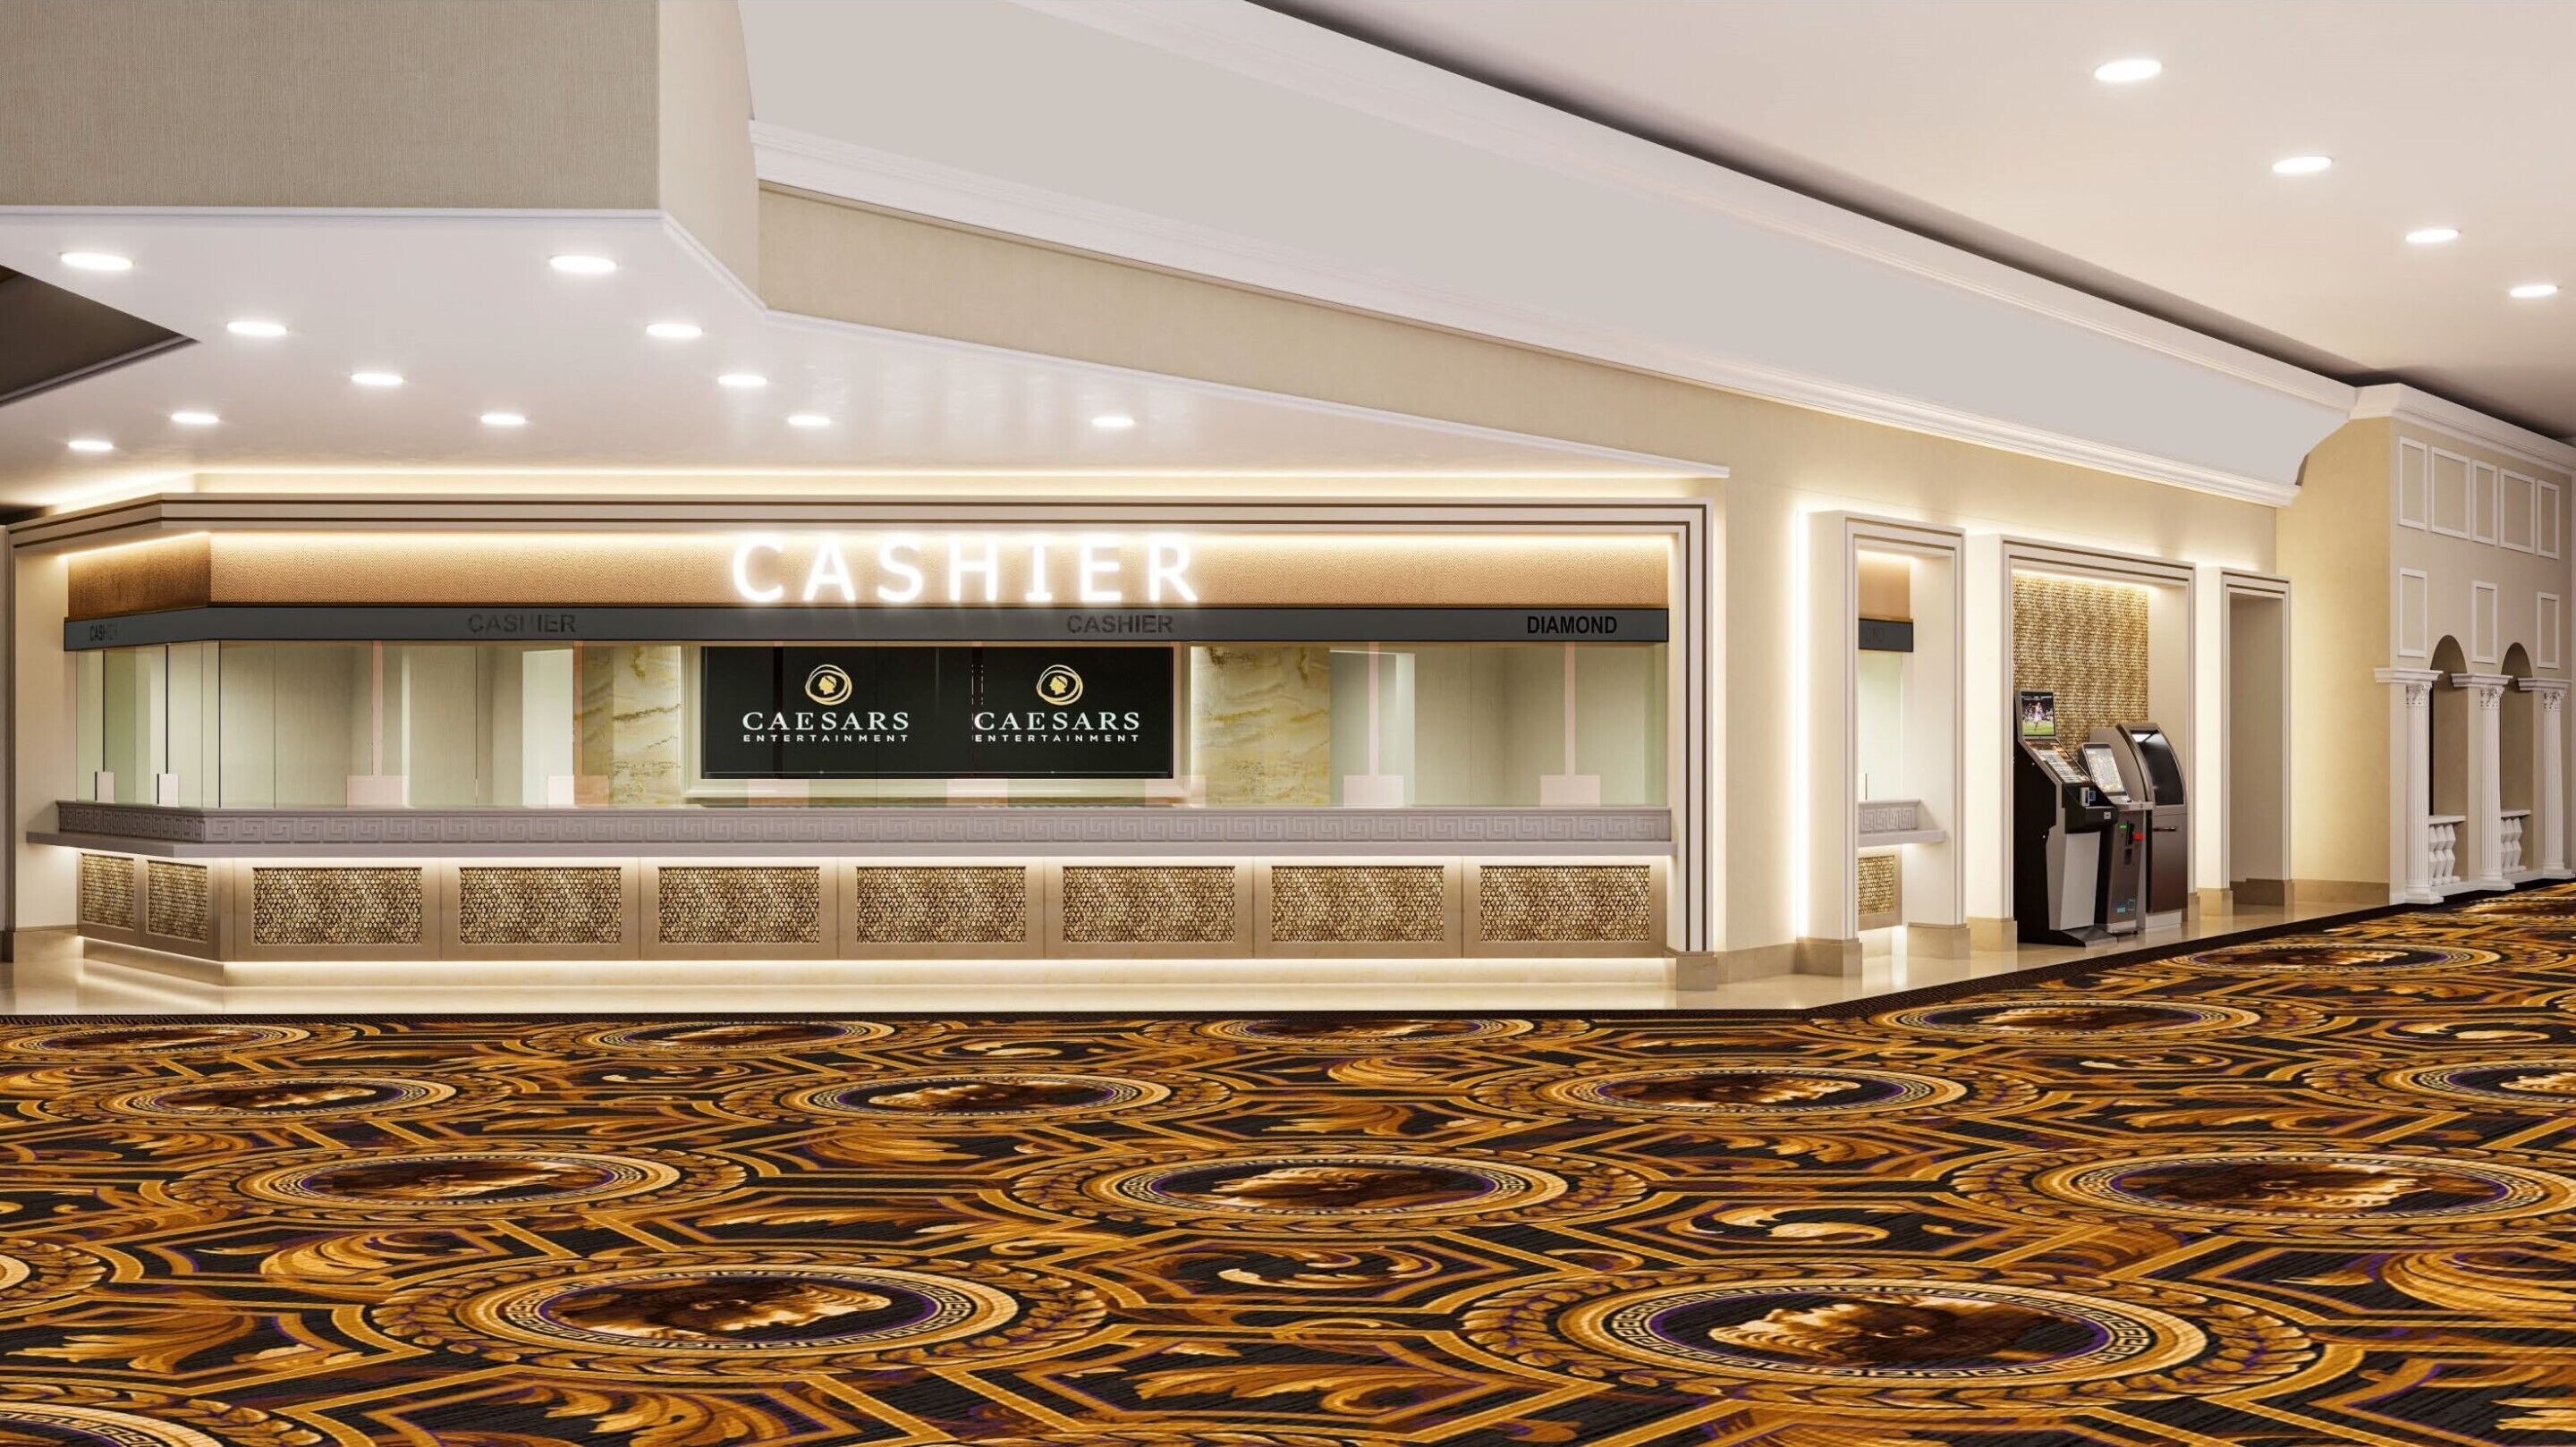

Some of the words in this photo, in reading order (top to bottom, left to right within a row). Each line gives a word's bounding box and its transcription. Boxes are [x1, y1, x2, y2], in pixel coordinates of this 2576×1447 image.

[732, 534, 1199, 603] CASHIER
[89, 622, 119, 642] CASH
[1066, 614, 1174, 634] CASHIER
[1527, 615, 1618, 635] DIAMOND
[741, 711, 909, 731] CAESARS
[973, 711, 1140, 731] CAESARS
[742, 734, 908, 742] ENTERTAINMENT
[974, 734, 1139, 742] ENTERTAINMENT
